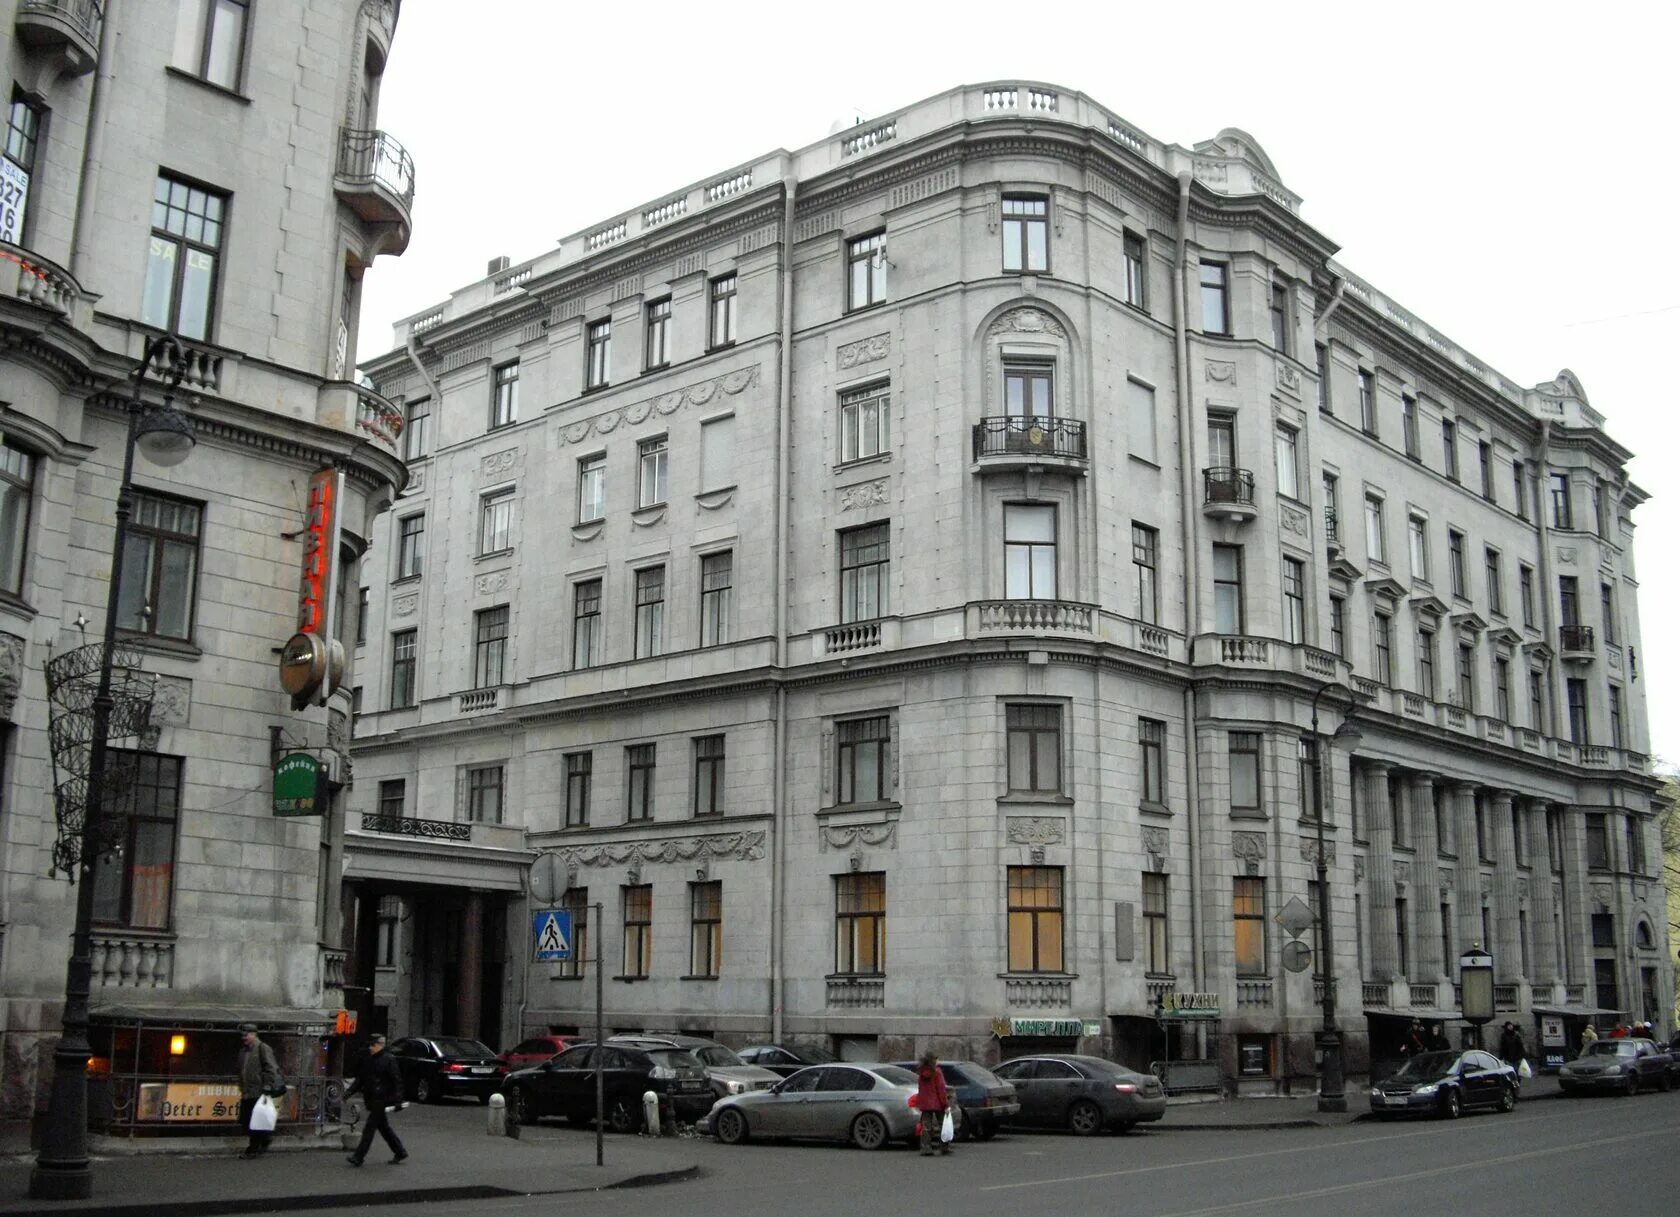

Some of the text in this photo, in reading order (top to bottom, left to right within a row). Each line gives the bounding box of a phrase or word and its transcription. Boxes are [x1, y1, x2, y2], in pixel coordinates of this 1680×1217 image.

[6, 164, 27, 187] SALE
[150, 240, 210, 271] SALE
[299, 481, 326, 628] ПИВНАЯ
[1173, 992, 1220, 1009] КУХНИ
[1014, 1019, 1084, 1036] МИРЕЛЛА
[198, 1085, 242, 1097] пивна
[161, 1101, 202, 1117] Peter
